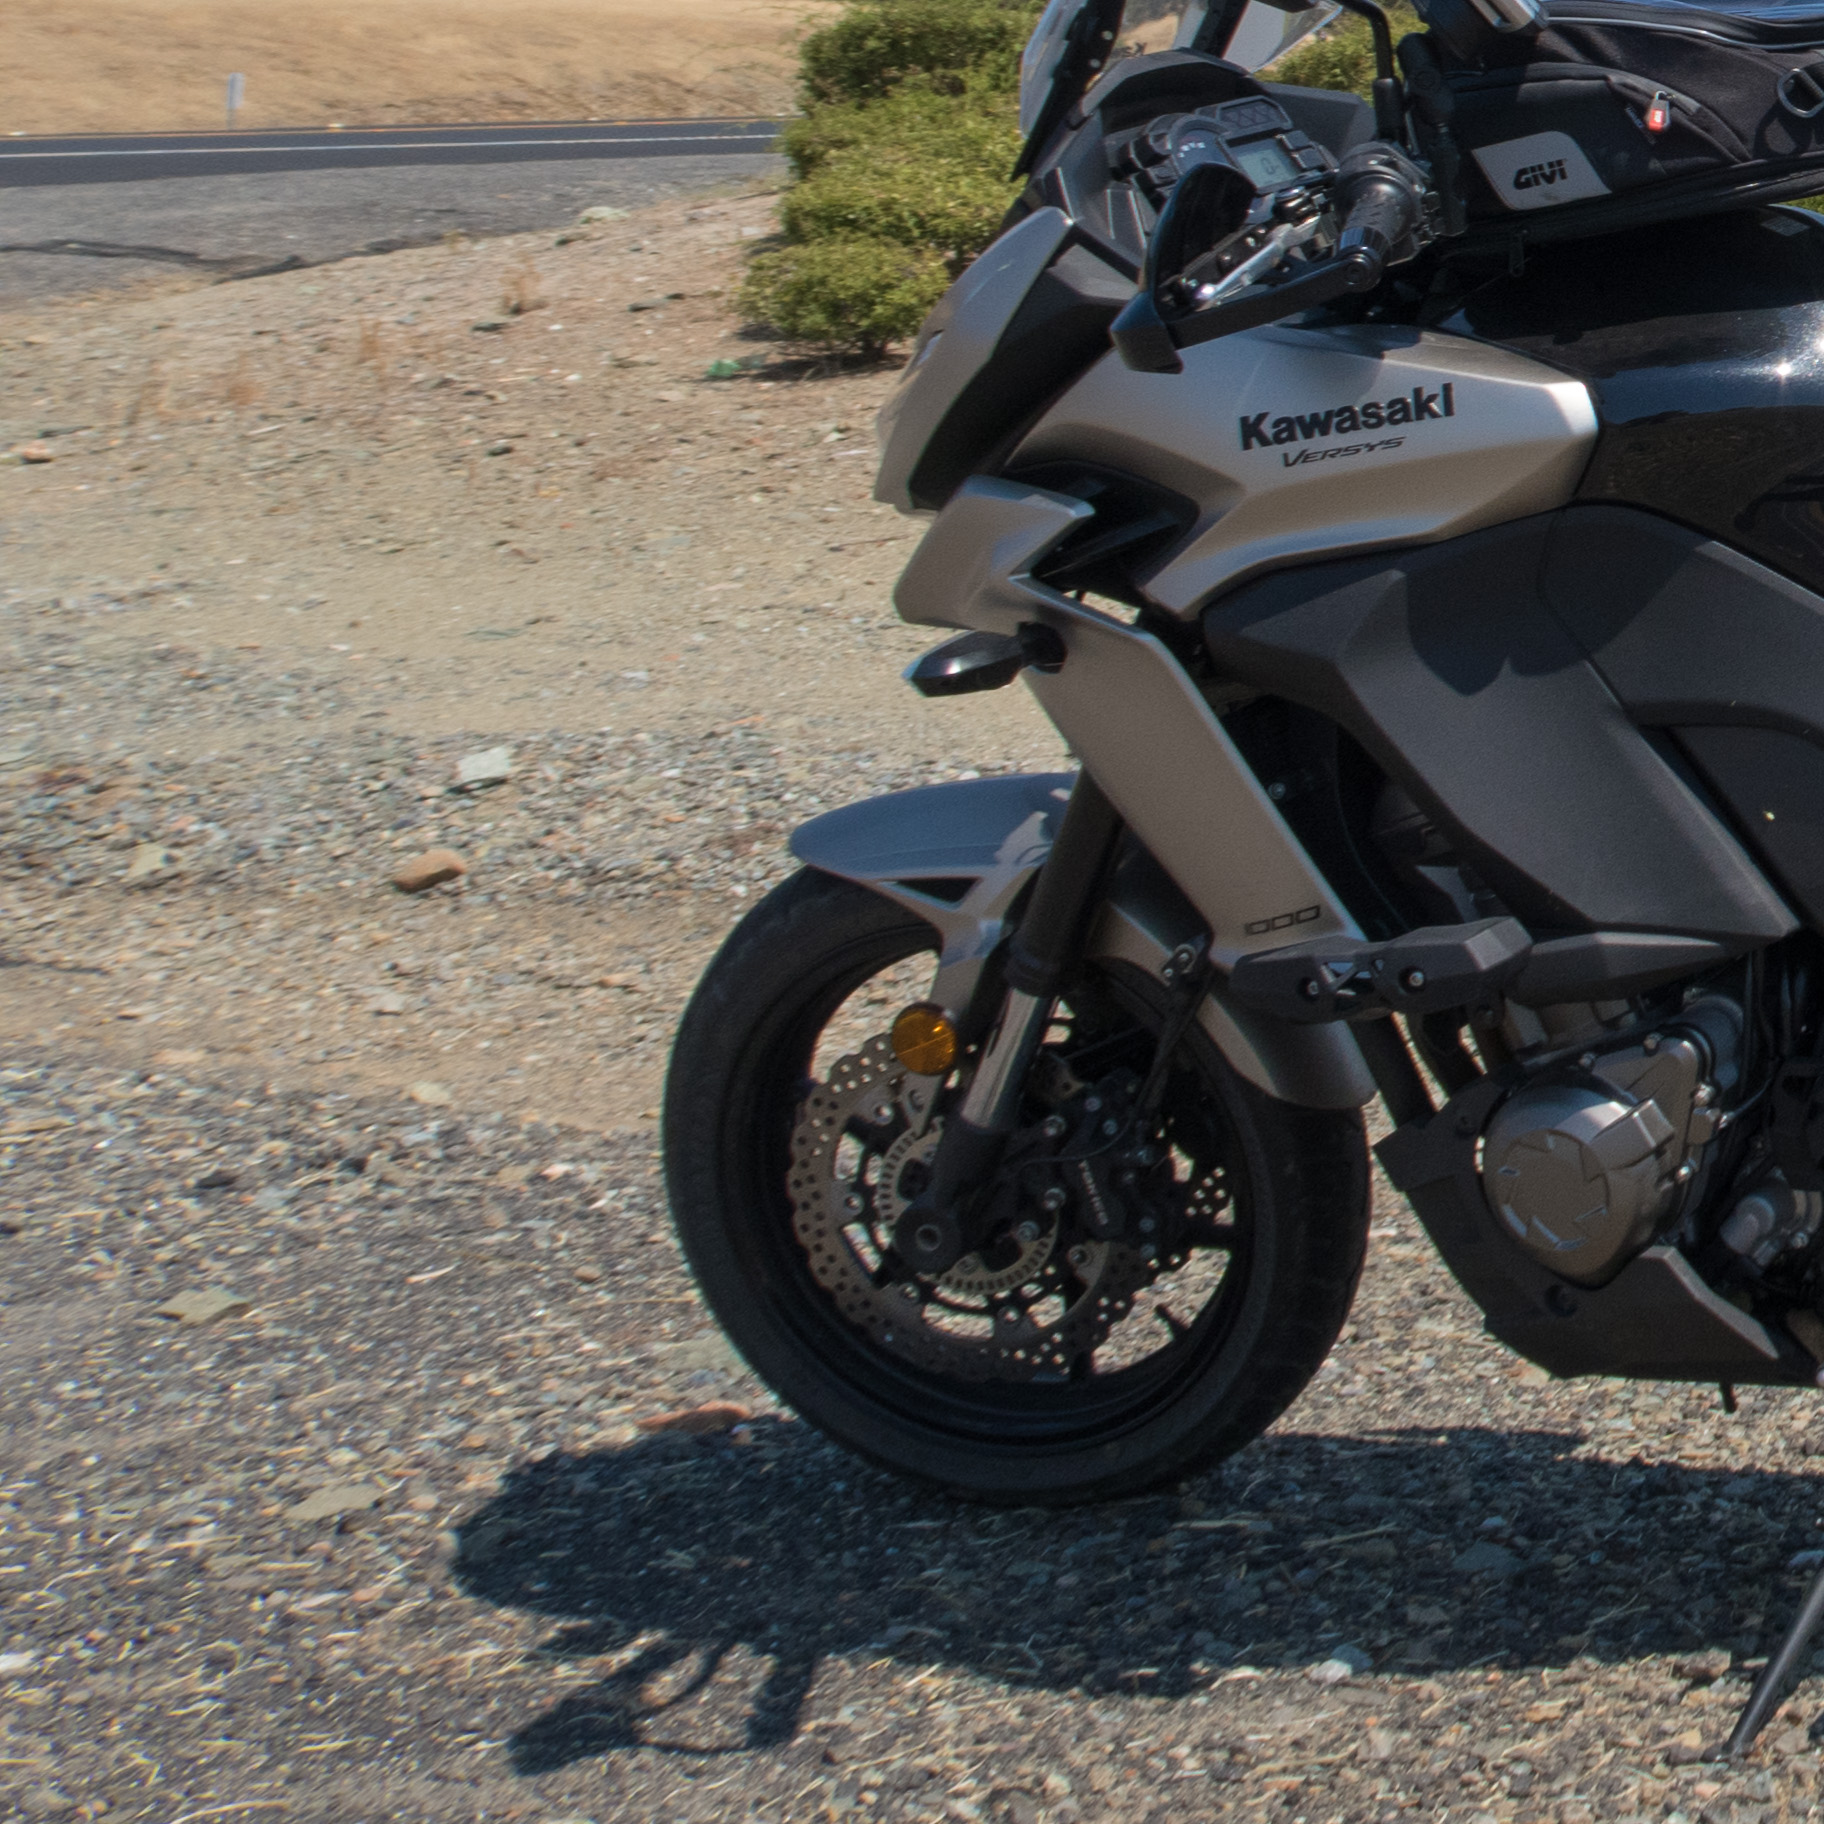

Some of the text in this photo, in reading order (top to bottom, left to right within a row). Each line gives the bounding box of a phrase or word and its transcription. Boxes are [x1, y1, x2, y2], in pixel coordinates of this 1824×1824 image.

[1514, 159, 1568, 190] GIVI
[1239, 382, 1455, 450] Kawasaki
[1283, 436, 1406, 467] VERSYS
